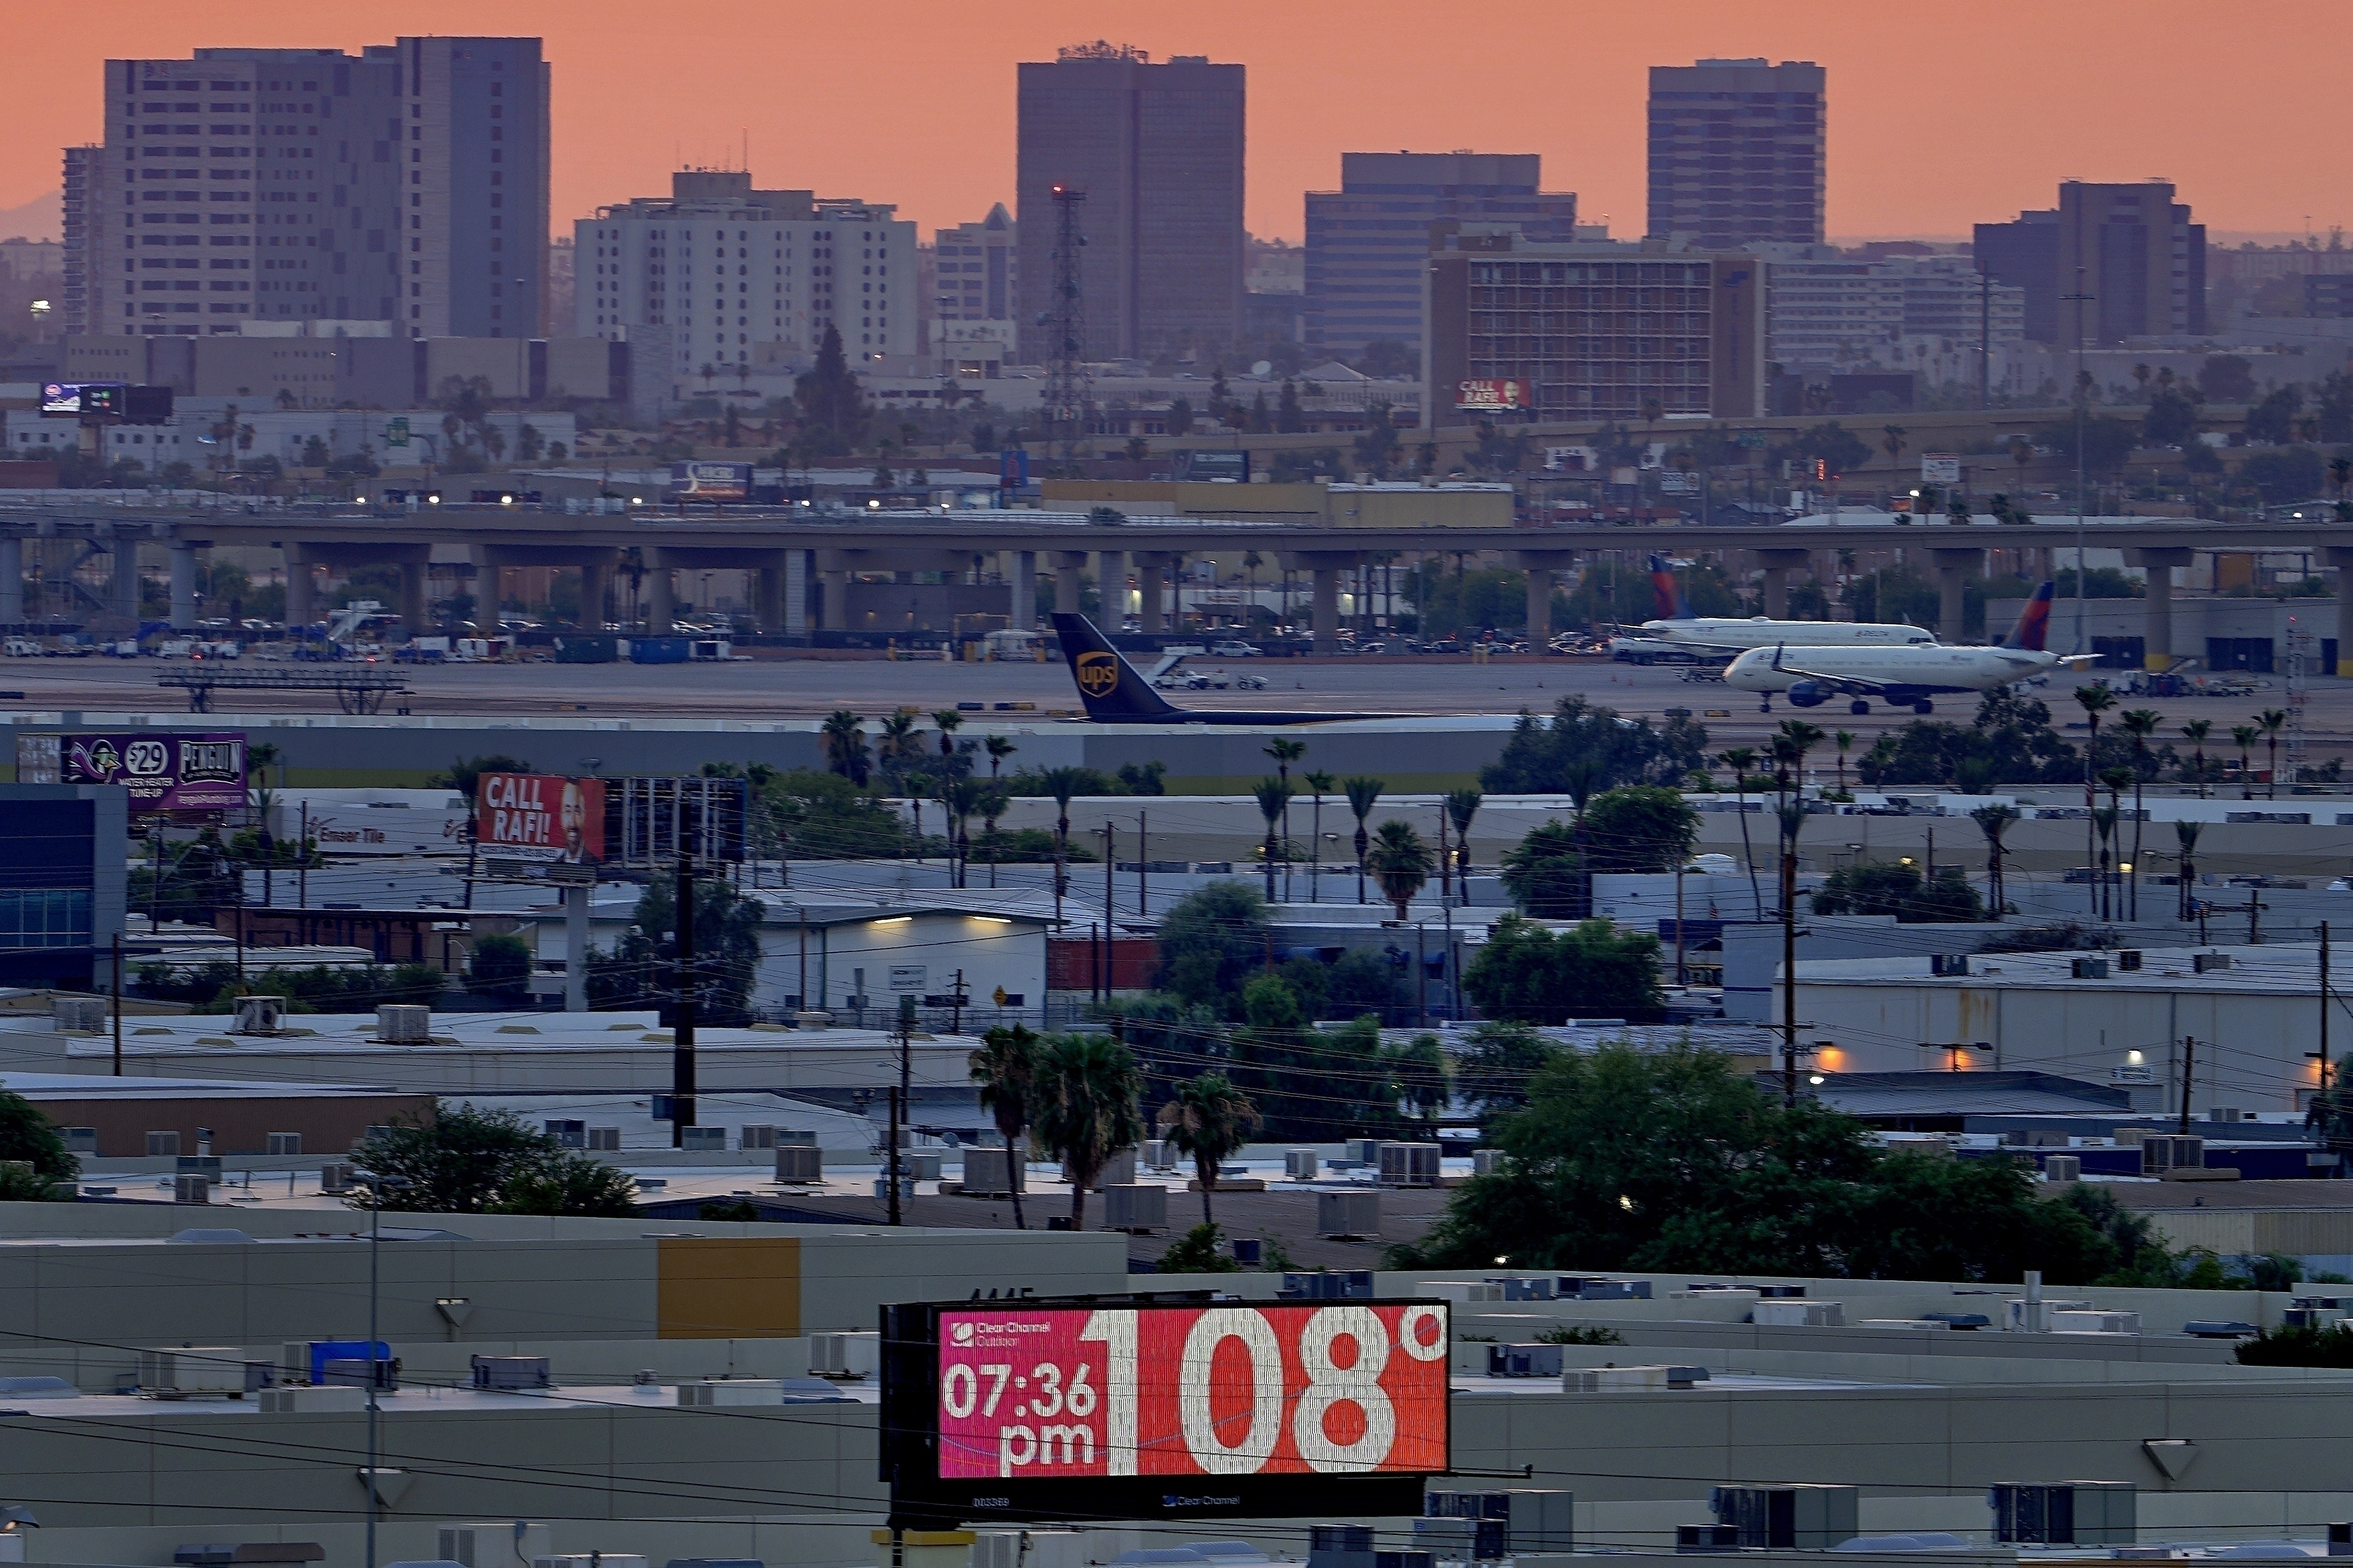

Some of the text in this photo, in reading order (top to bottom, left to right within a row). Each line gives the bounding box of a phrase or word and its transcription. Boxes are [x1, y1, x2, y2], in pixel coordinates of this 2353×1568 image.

[1459, 380, 1496, 392] CALL
[1081, 666, 1115, 690] ups
[129, 743, 163, 772] $29
[180, 743, 241, 774] PENGUIN
[117, 778, 174, 787] WATER HEATER
[128, 789, 164, 799] TUNE-UP
[485, 776, 545, 811] CALL
[363, 828, 385, 843] Tile
[492, 809, 552, 844] RAFI!
[977, 1321, 1051, 1333] Clear Channel
[977, 1336, 1018, 1347] Outdoor
[942, 1362, 1096, 1419] 07:36
[999, 1422, 1095, 1478] pm
[1176, 1495, 1240, 1506] Clear Channel
